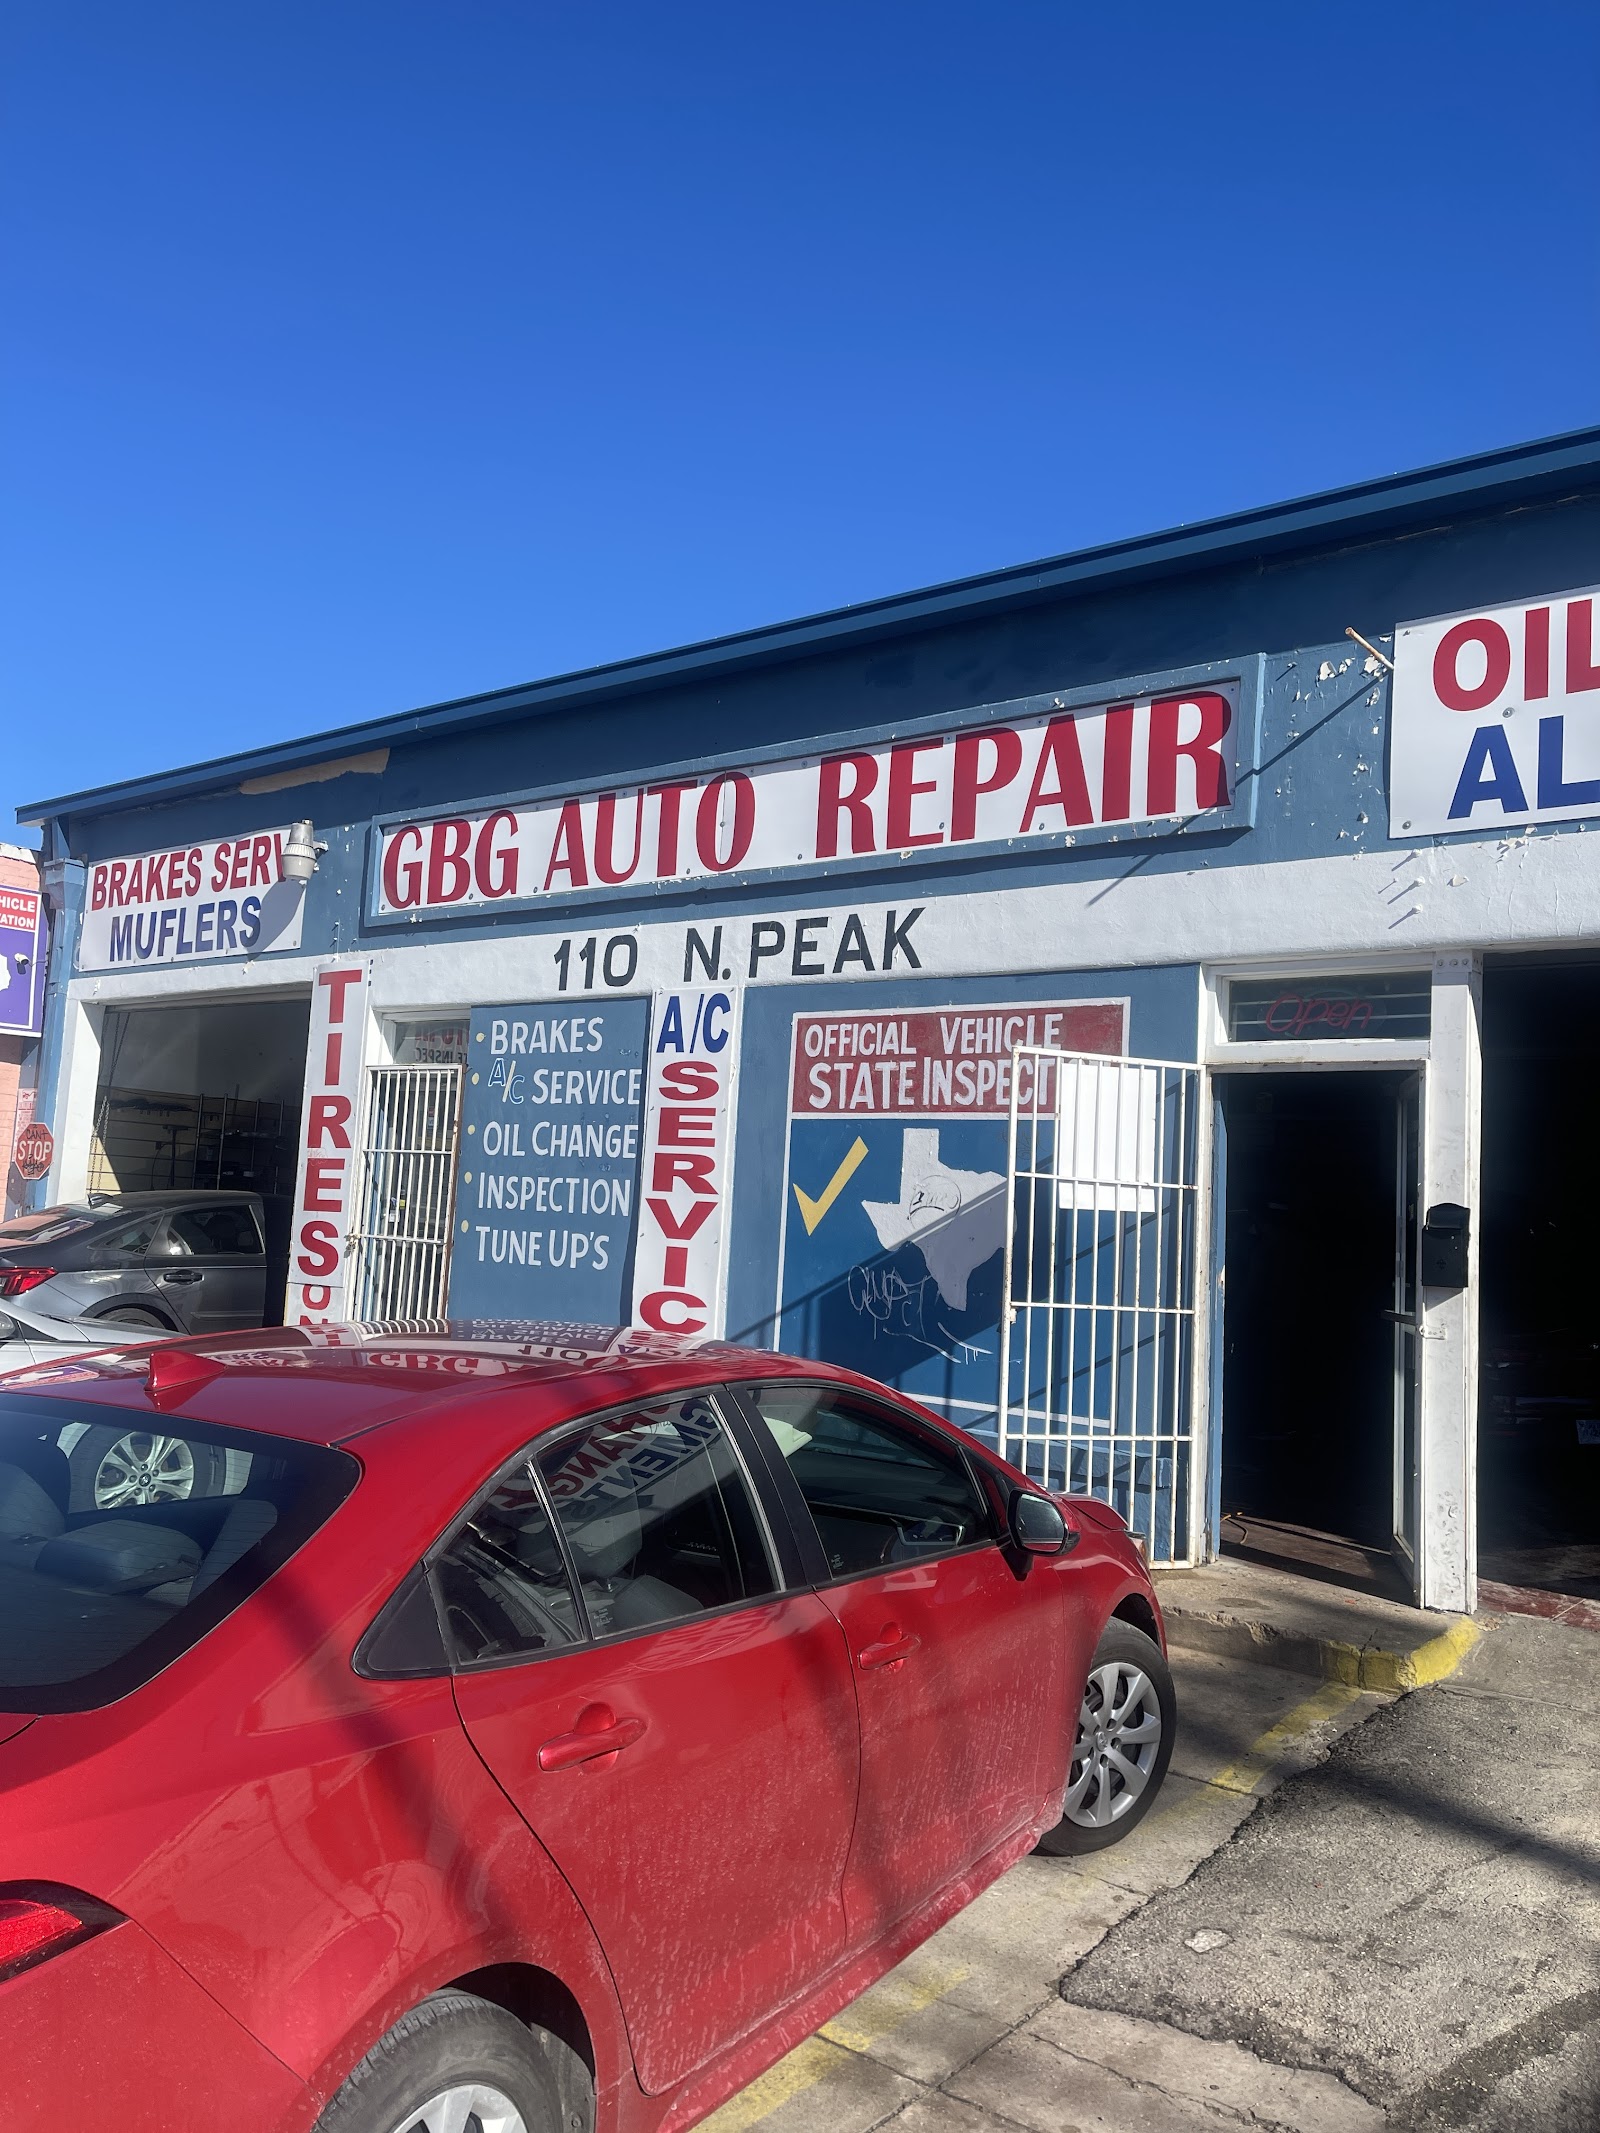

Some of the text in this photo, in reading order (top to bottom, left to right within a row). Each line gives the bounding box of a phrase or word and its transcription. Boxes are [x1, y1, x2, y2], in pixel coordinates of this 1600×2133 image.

[1433, 598, 1600, 712] OIL
[1446, 714, 1600, 821] AL
[384, 690, 1232, 909] GBG AUTO REPAIR
[91, 848, 202, 911] BRAKES
[0, 912, 34, 929] ATION
[109, 895, 261, 963] MUFLERS
[553, 907, 926, 991] 110 N. PEAK
[490, 1016, 604, 1055] BRAKES
[656, 993, 731, 1054] A/C
[804, 1013, 1063, 1058] OFFICIAL VEHICLE
[1265, 993, 1374, 1036] Open
[487, 1057, 643, 1105] A/C SERVICE
[808, 1059, 916, 1110] STATE
[297, 969, 362, 1277] TIRES
[483, 1120, 639, 1159] OIL CHANGE
[18, 1140, 52, 1161] STOP
[478, 1171, 631, 1217] INSPECTION
[475, 1225, 610, 1271] TUNE UP'S
